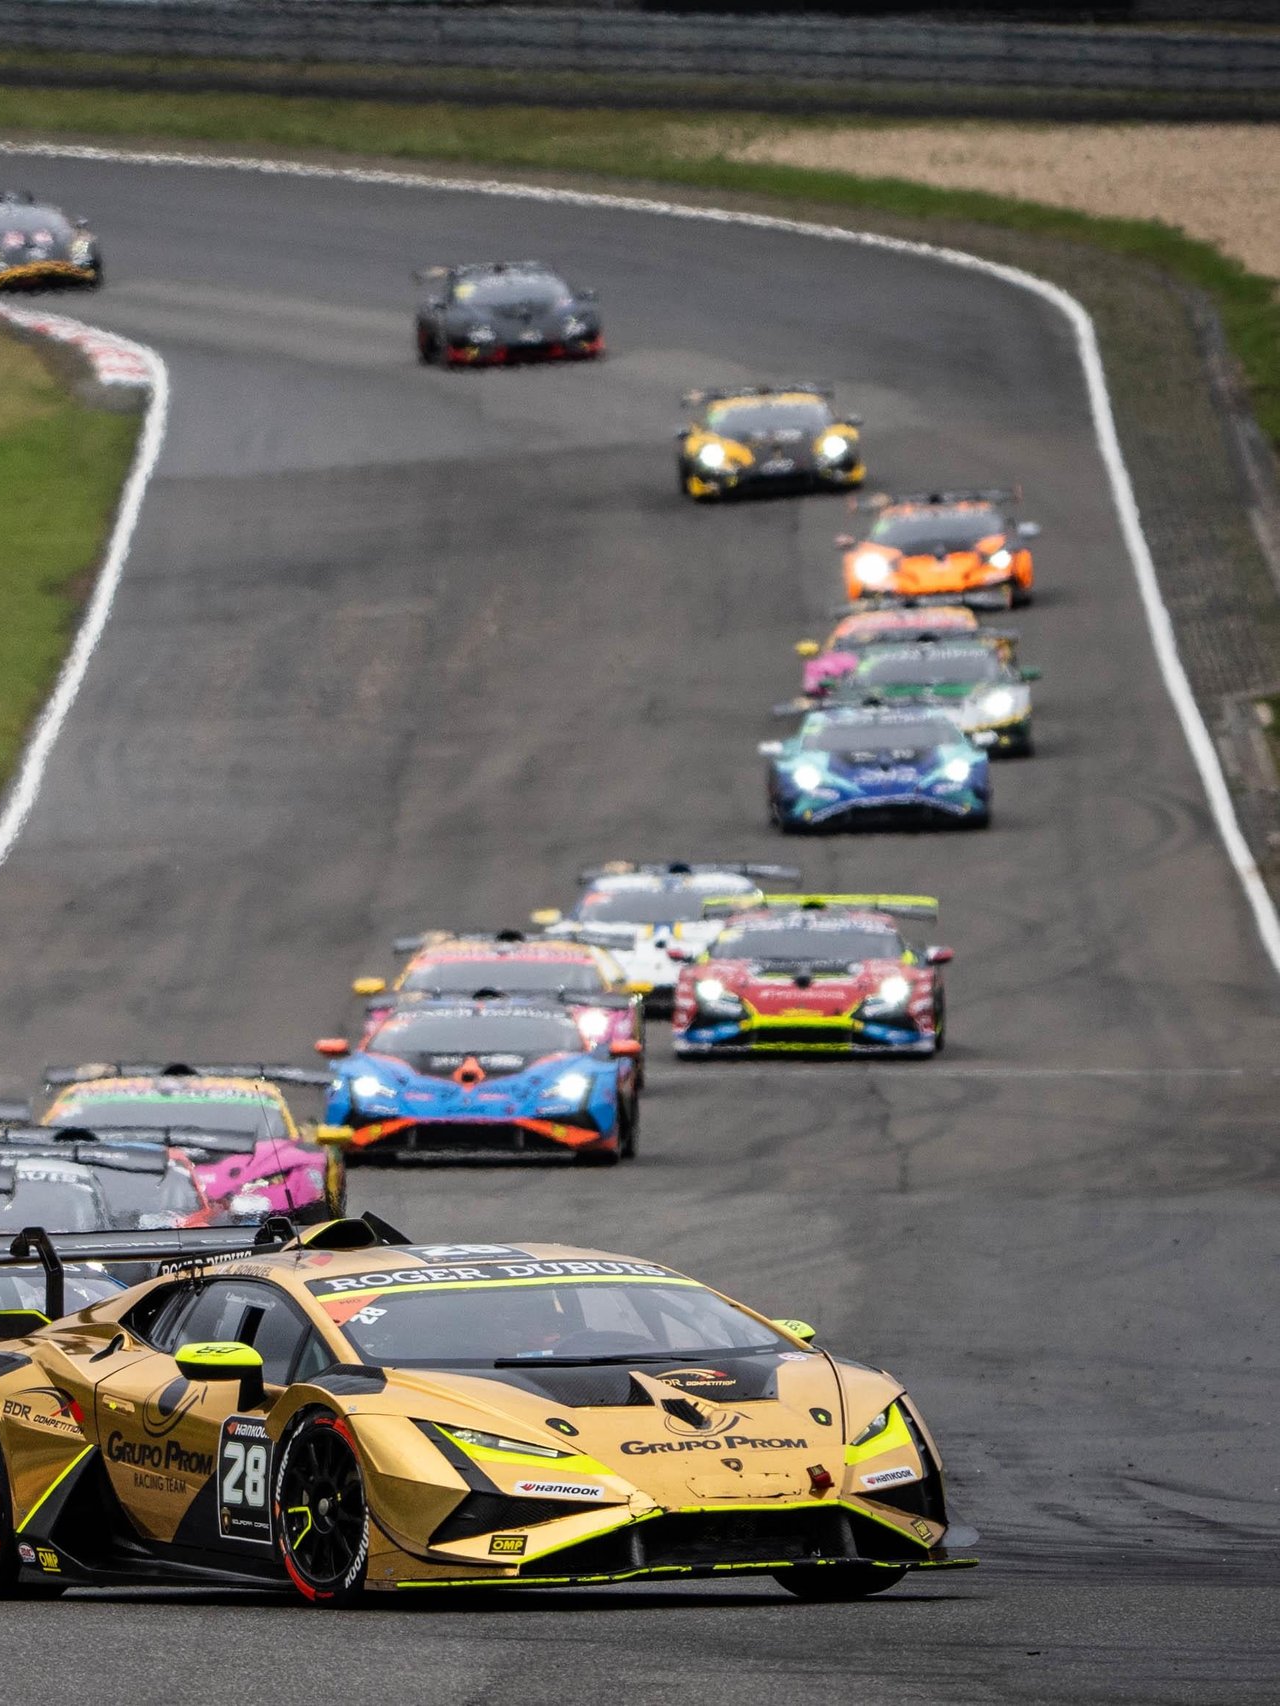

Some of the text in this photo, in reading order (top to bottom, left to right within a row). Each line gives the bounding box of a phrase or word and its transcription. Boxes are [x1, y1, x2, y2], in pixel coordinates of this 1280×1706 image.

[326, 1261, 668, 1292] ROGER DUBUIS
[3, 1400, 85, 1436] BDR COMPETITION
[108, 1430, 214, 1476] GRUPO PROM
[620, 1435, 809, 1456] GRUPO PROM
[134, 1472, 187, 1495] RACING TEAM
[222, 1440, 267, 1507] 28
[492, 1540, 524, 1551] OMP
[38, 1551, 59, 1568] OMP
